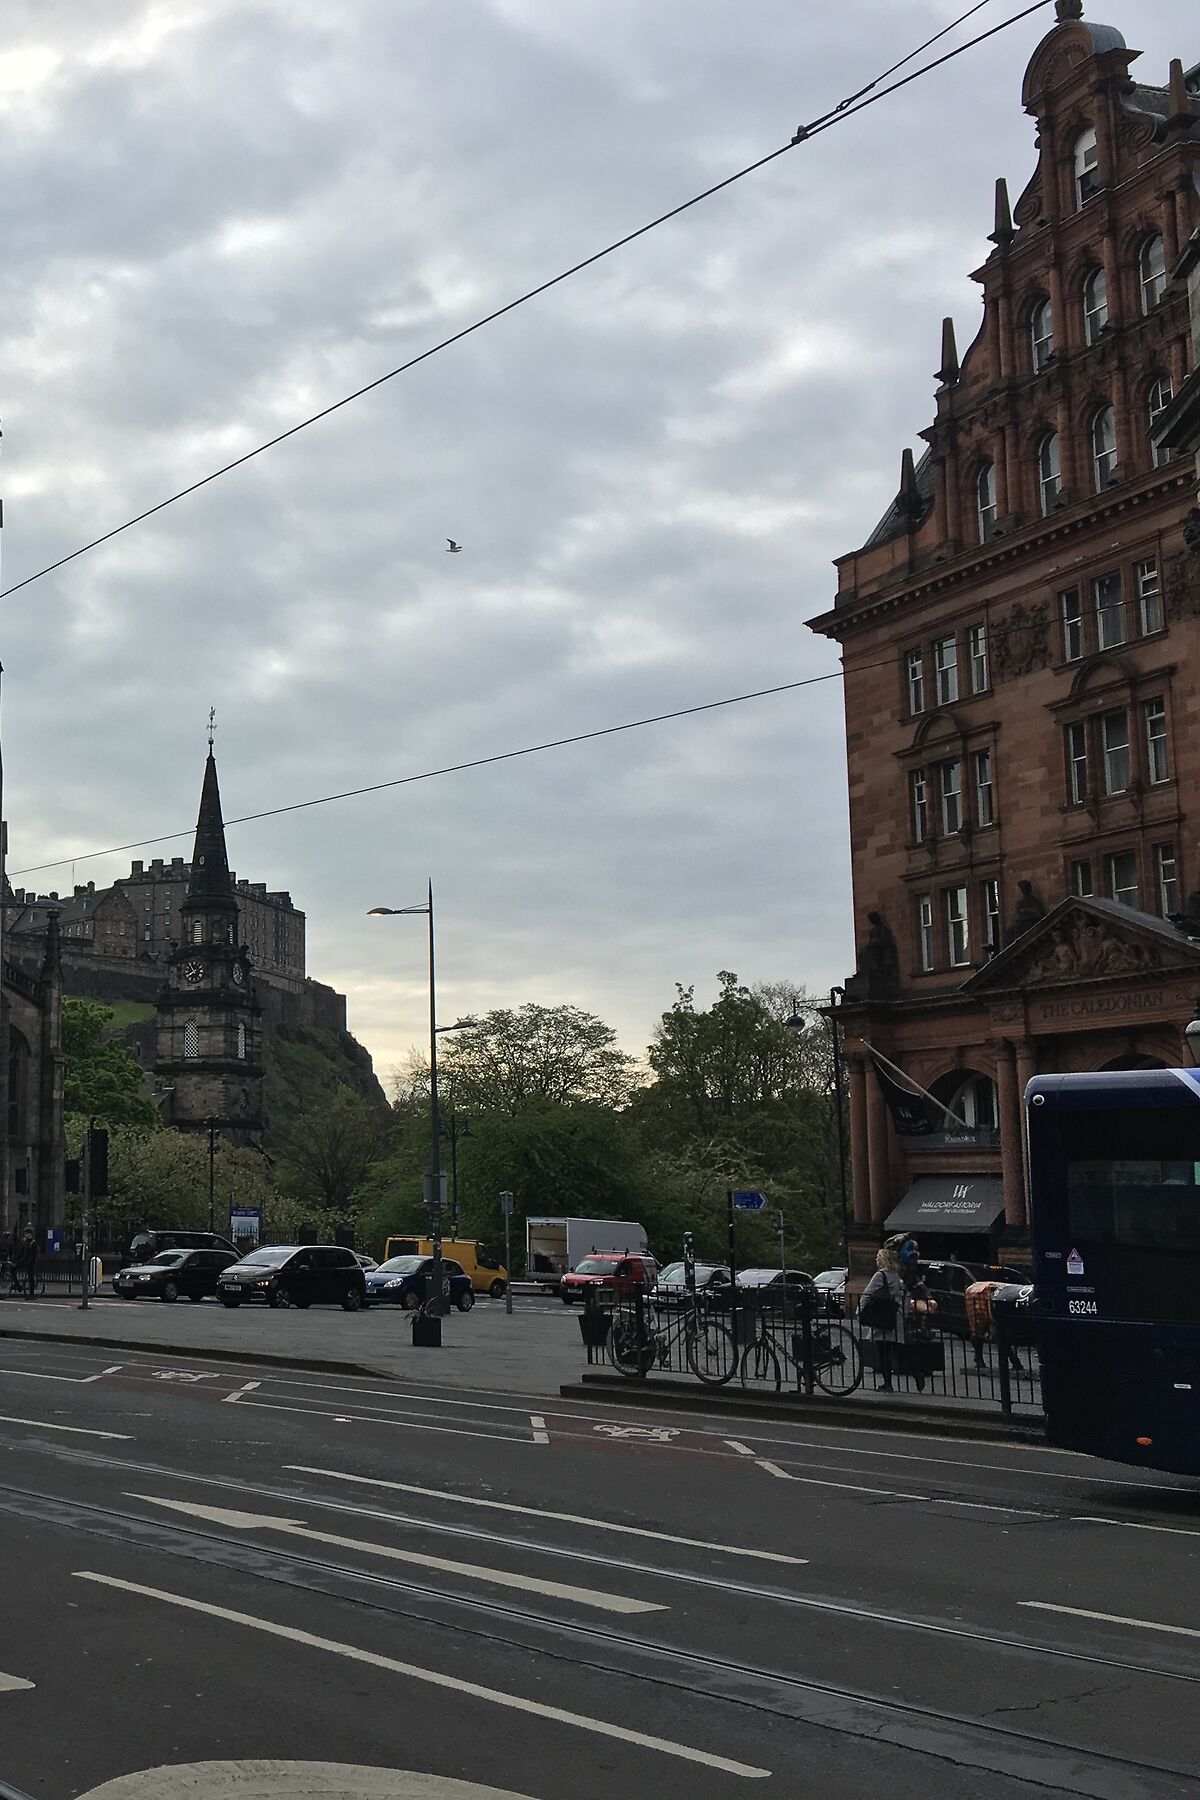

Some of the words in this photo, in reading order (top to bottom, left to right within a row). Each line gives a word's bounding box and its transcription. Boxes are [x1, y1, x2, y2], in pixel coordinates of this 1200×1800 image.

[1040, 1003, 1069, 1018] THE
[1071, 991, 1163, 1016] CALEDONIAN
[1069, 1300, 1097, 1314] 63244
